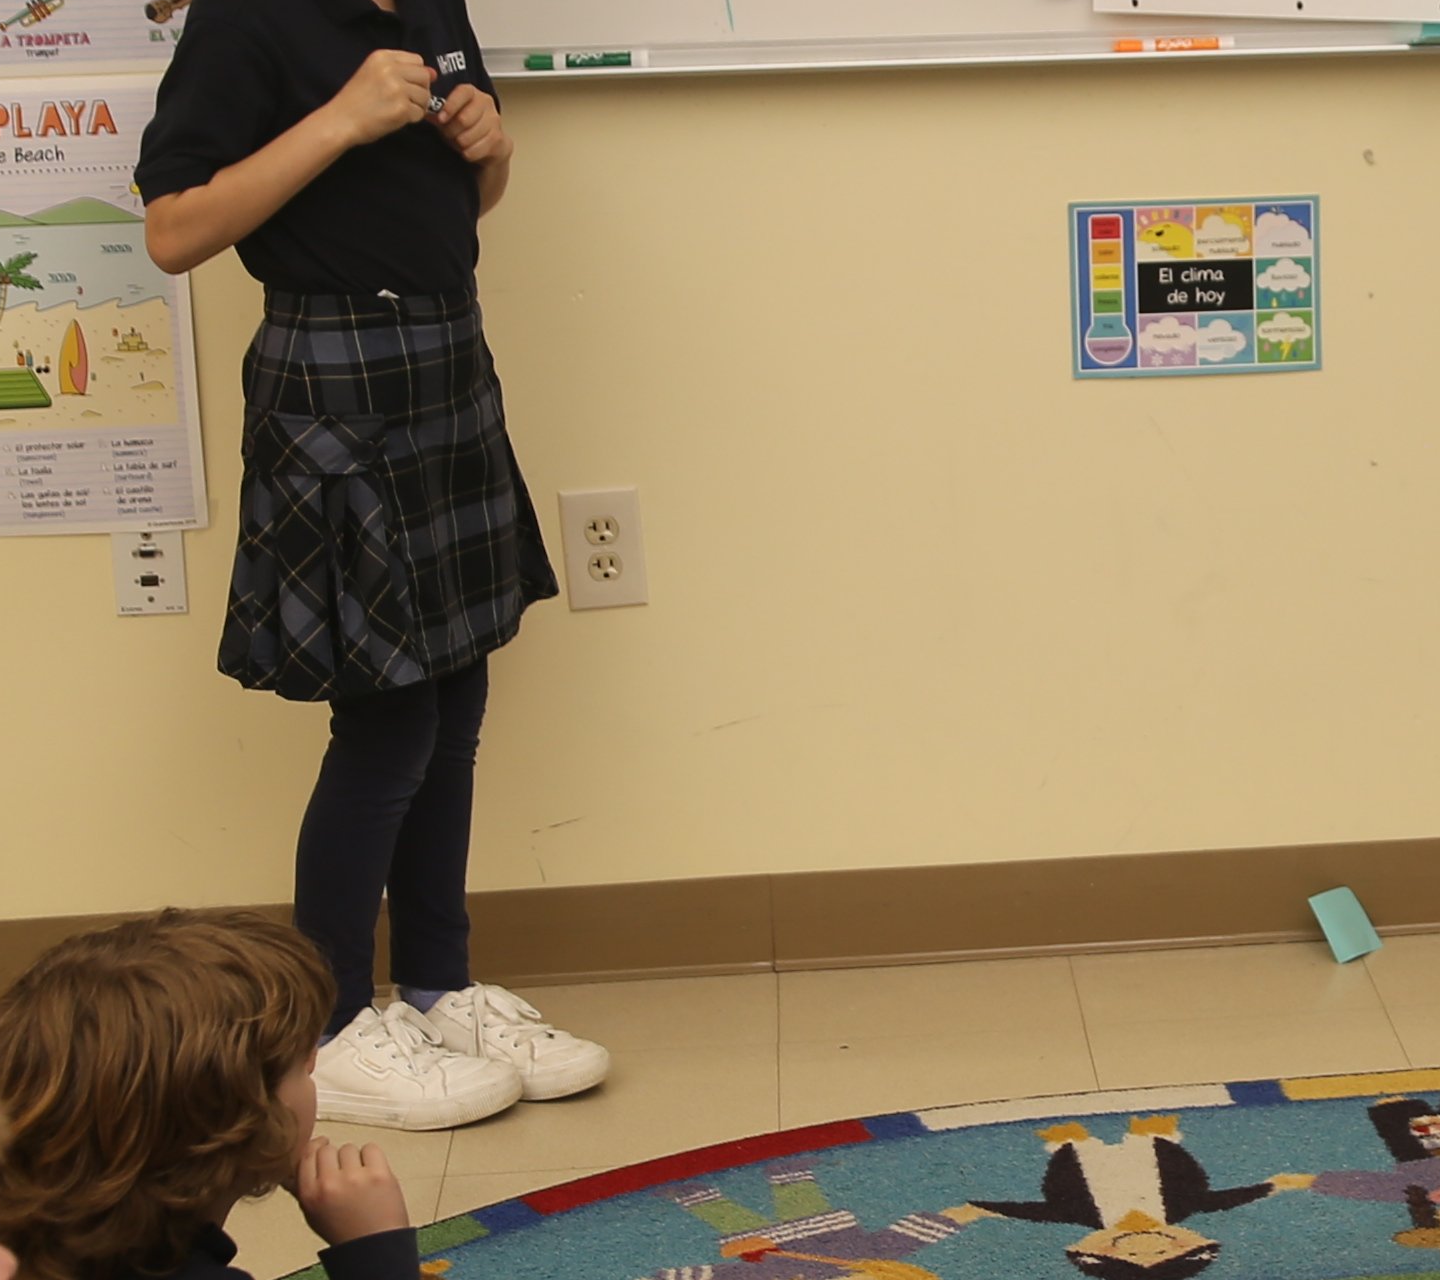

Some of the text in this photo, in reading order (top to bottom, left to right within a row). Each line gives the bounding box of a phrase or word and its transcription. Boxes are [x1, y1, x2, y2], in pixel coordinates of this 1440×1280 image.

[13, 145, 65, 164] Beach
[1158, 266, 1225, 284] El clima
[1166, 286, 1227, 306] de hoy
